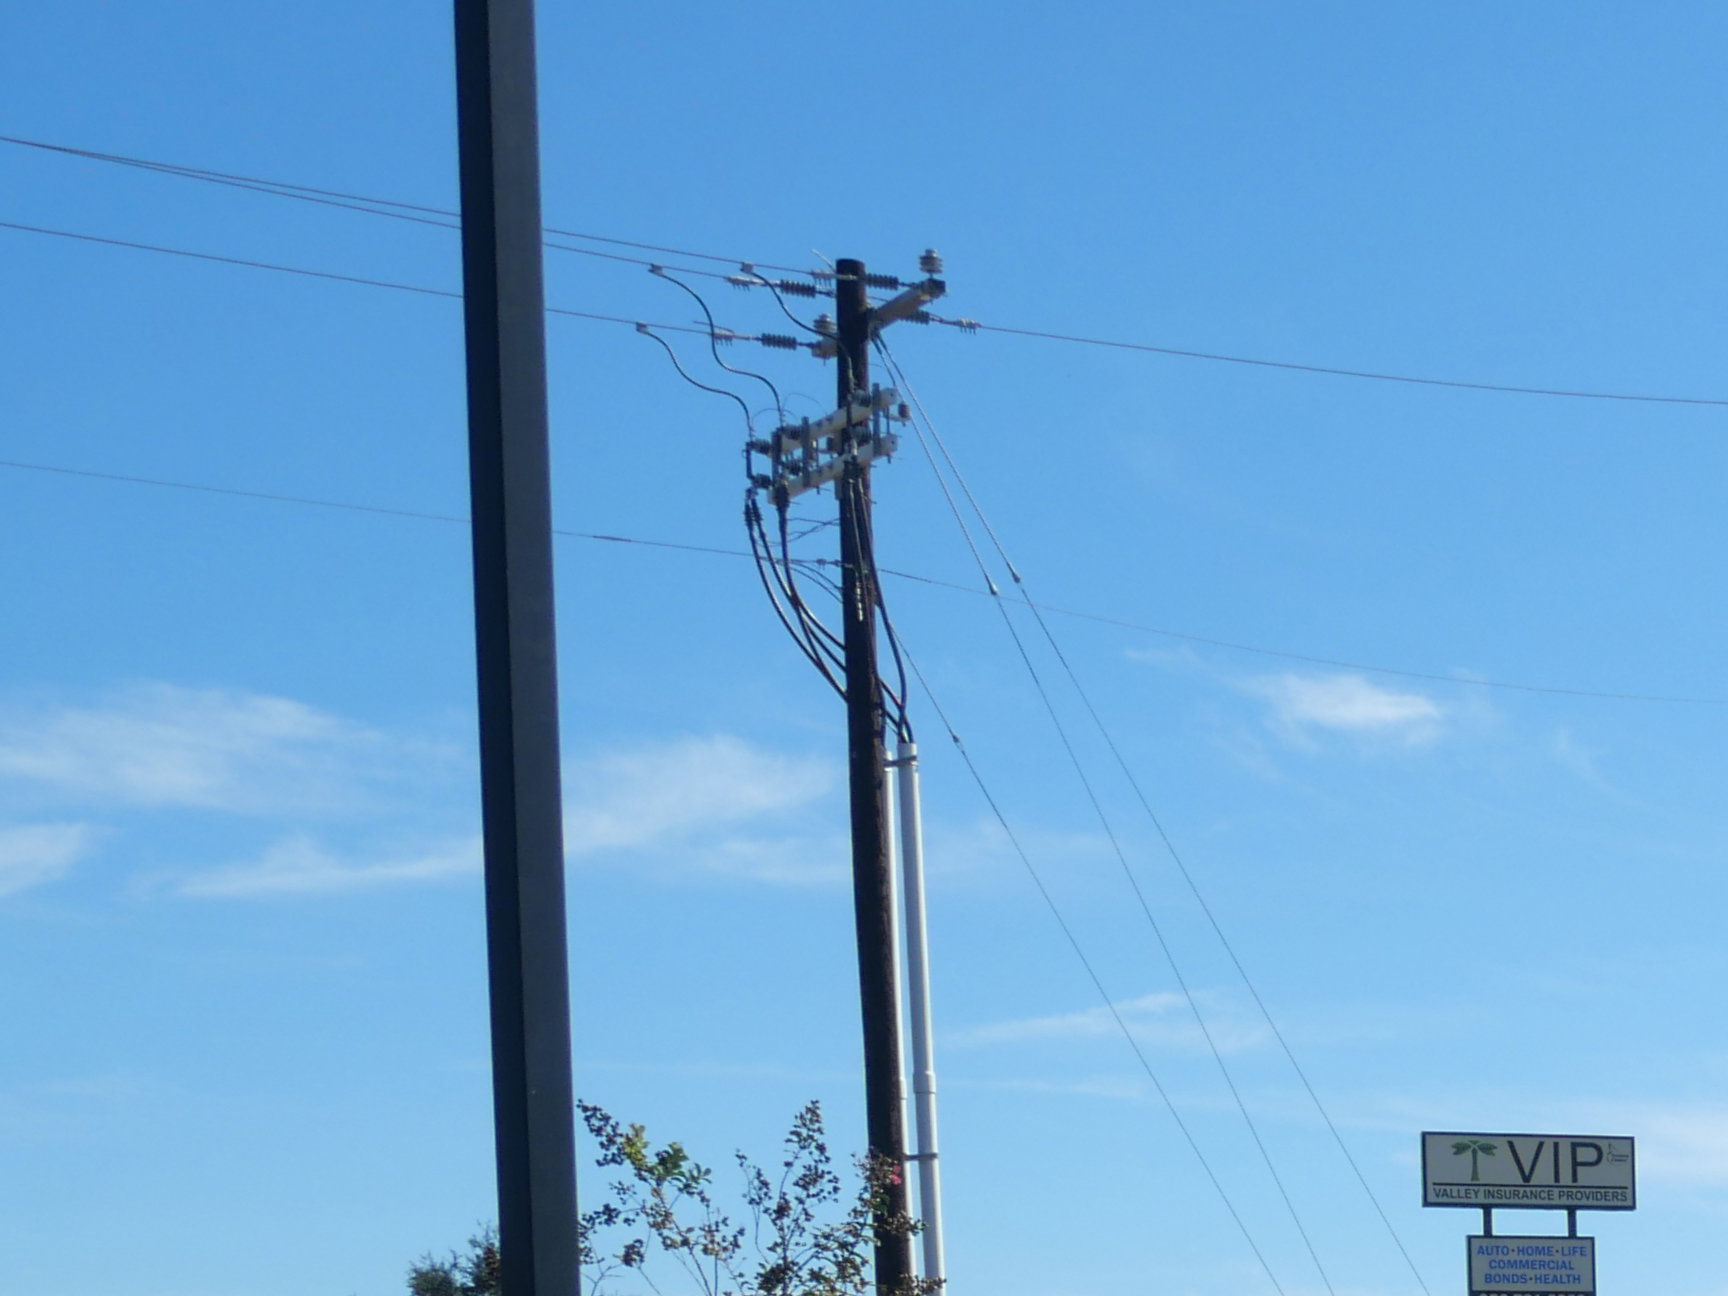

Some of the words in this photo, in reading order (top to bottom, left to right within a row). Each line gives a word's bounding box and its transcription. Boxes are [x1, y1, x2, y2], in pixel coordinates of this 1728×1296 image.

[1506, 1140, 1602, 1184] VIP
[1432, 1187, 1480, 1200] VALLEY
[1483, 1188, 1554, 1201] INSURANCE
[1558, 1190, 1628, 1202] PROVIDERS
[1477, 1245, 1510, 1257] AUTO
[1516, 1246, 1554, 1257] HOME
[1561, 1246, 1588, 1257] LIFE
[1488, 1259, 1575, 1271] COMMERCIAL
[1484, 1273, 1528, 1284] BONDS
[1534, 1274, 1581, 1285] HEALTH
